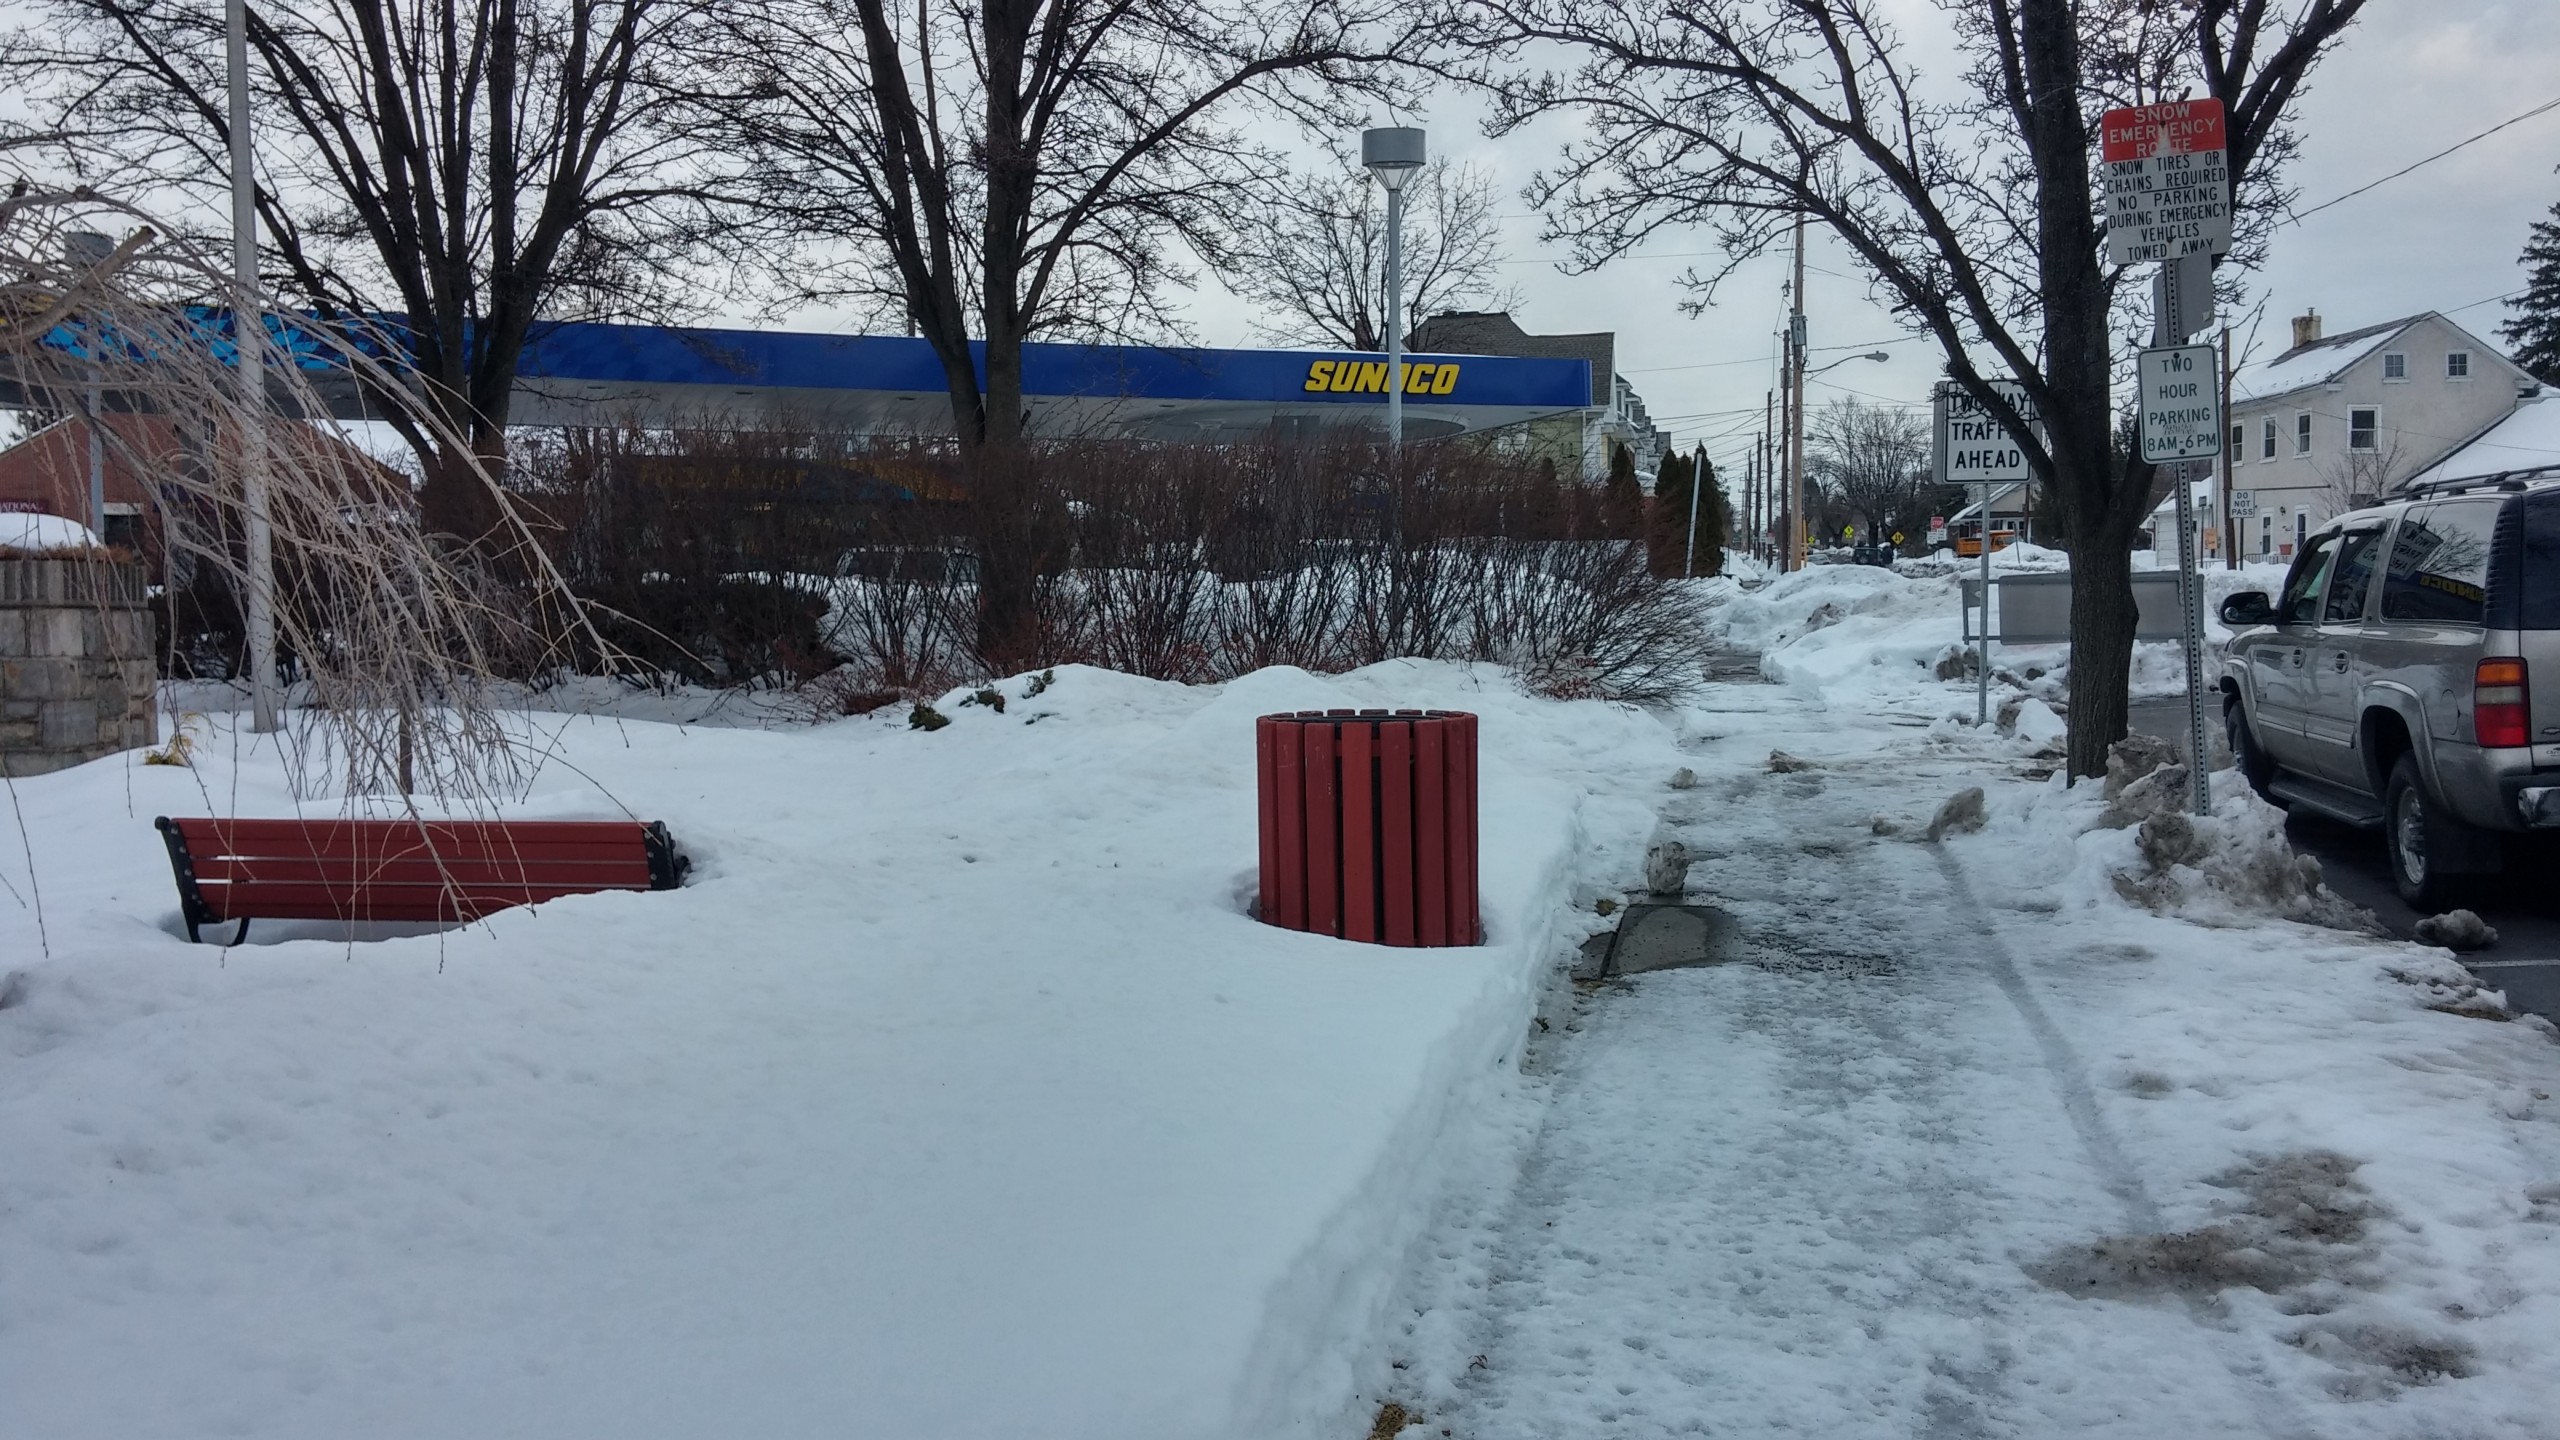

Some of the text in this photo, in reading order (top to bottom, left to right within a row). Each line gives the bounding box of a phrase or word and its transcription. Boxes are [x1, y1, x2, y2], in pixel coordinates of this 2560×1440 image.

[2134, 103, 2190, 123] SNOW
[2109, 117, 2216, 144] EMERENCY
[2136, 137, 2193, 158] ROTE
[2111, 151, 2220, 177] SNOW TIRES OR
[2106, 167, 2226, 194] CHAINS REQUIRED
[2117, 187, 2218, 211] NO PARKING
[2109, 202, 2227, 229] DURING EMERGENCY
[2140, 223, 2200, 244] VEHICLES
[2127, 238, 2214, 261] TOWED AWAY
[2161, 357, 2193, 373] TWO
[1304, 360, 1461, 395] SUNOCO
[2159, 383, 2198, 399] HOUR
[2149, 407, 2211, 426] PARKING
[1951, 421, 2014, 441] TRAFF
[1955, 450, 2020, 469] AHEAD
[2231, 508, 2253, 516] PASS
